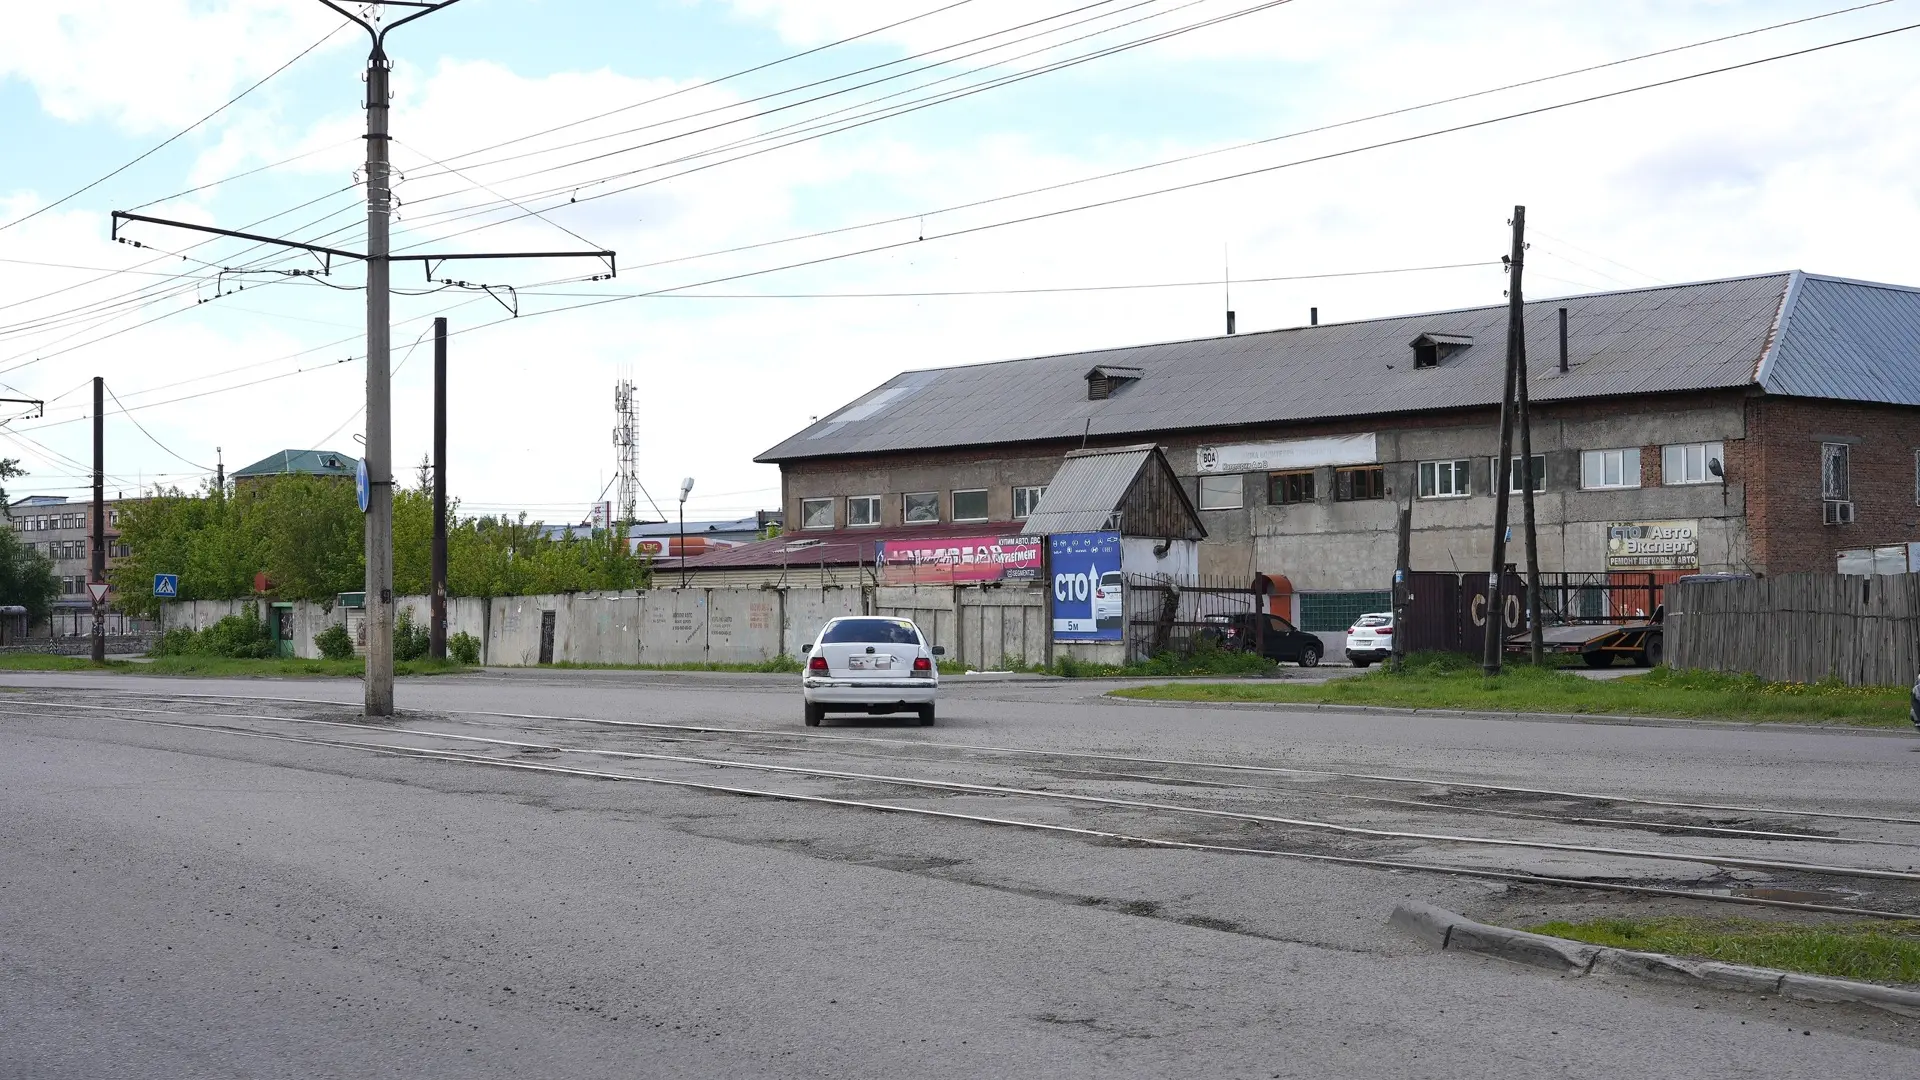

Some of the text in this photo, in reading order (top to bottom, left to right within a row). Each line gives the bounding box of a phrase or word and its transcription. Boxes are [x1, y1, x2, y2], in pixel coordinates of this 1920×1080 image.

[1611, 526, 1642, 539] СТО
[1030, 536, 1041, 544] ДВС
[1628, 540, 1693, 554] Эксперт
[1610, 555, 1696, 565] РЕМОНТ ЛЕГКОВЫХ АВТО
[1055, 573, 1088, 602] СТО
[1471, 593, 1520, 629] СО
